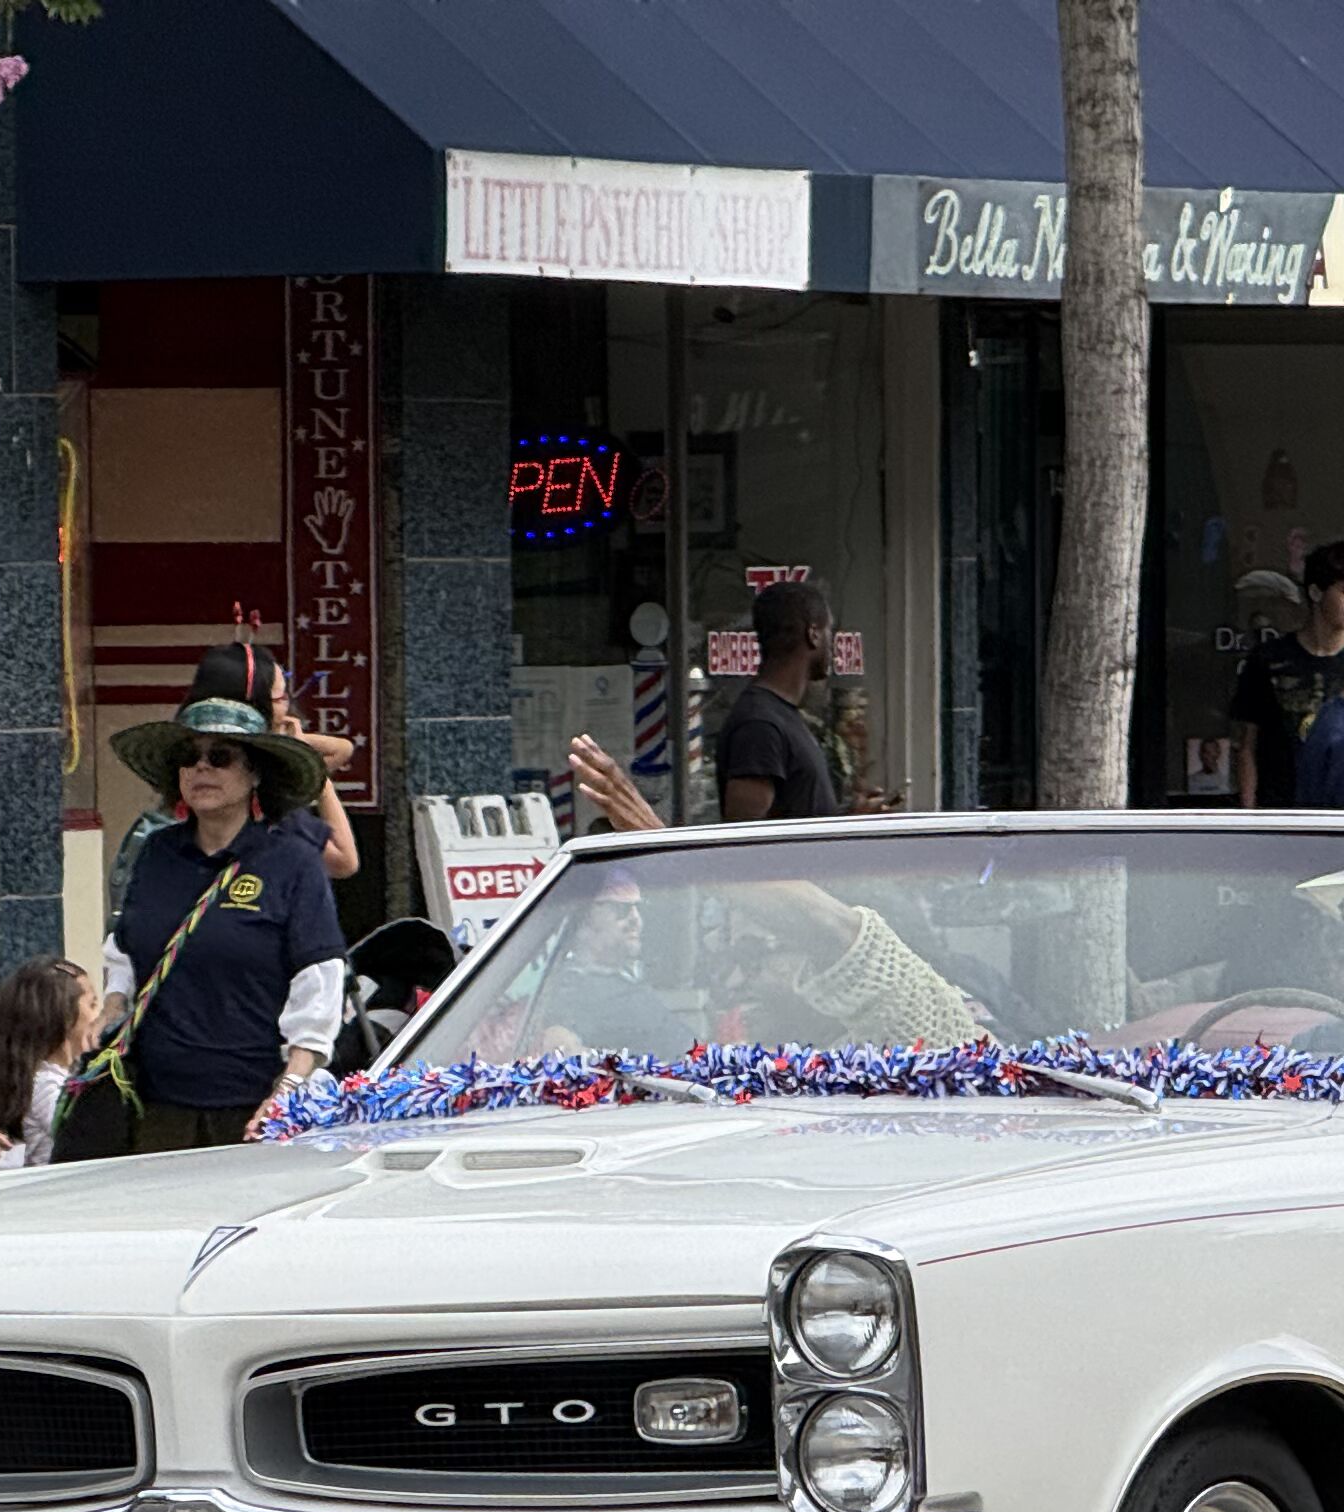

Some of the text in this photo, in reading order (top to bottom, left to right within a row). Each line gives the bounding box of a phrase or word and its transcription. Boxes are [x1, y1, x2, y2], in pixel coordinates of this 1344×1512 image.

[924, 188, 1019, 279] Bella
[1200, 205, 1306, 305] Waxing
[508, 451, 621, 515] PEN
[834, 632, 864, 676] SPA
[453, 867, 535, 895] OPEN
[414, 1399, 597, 1427] GTO
